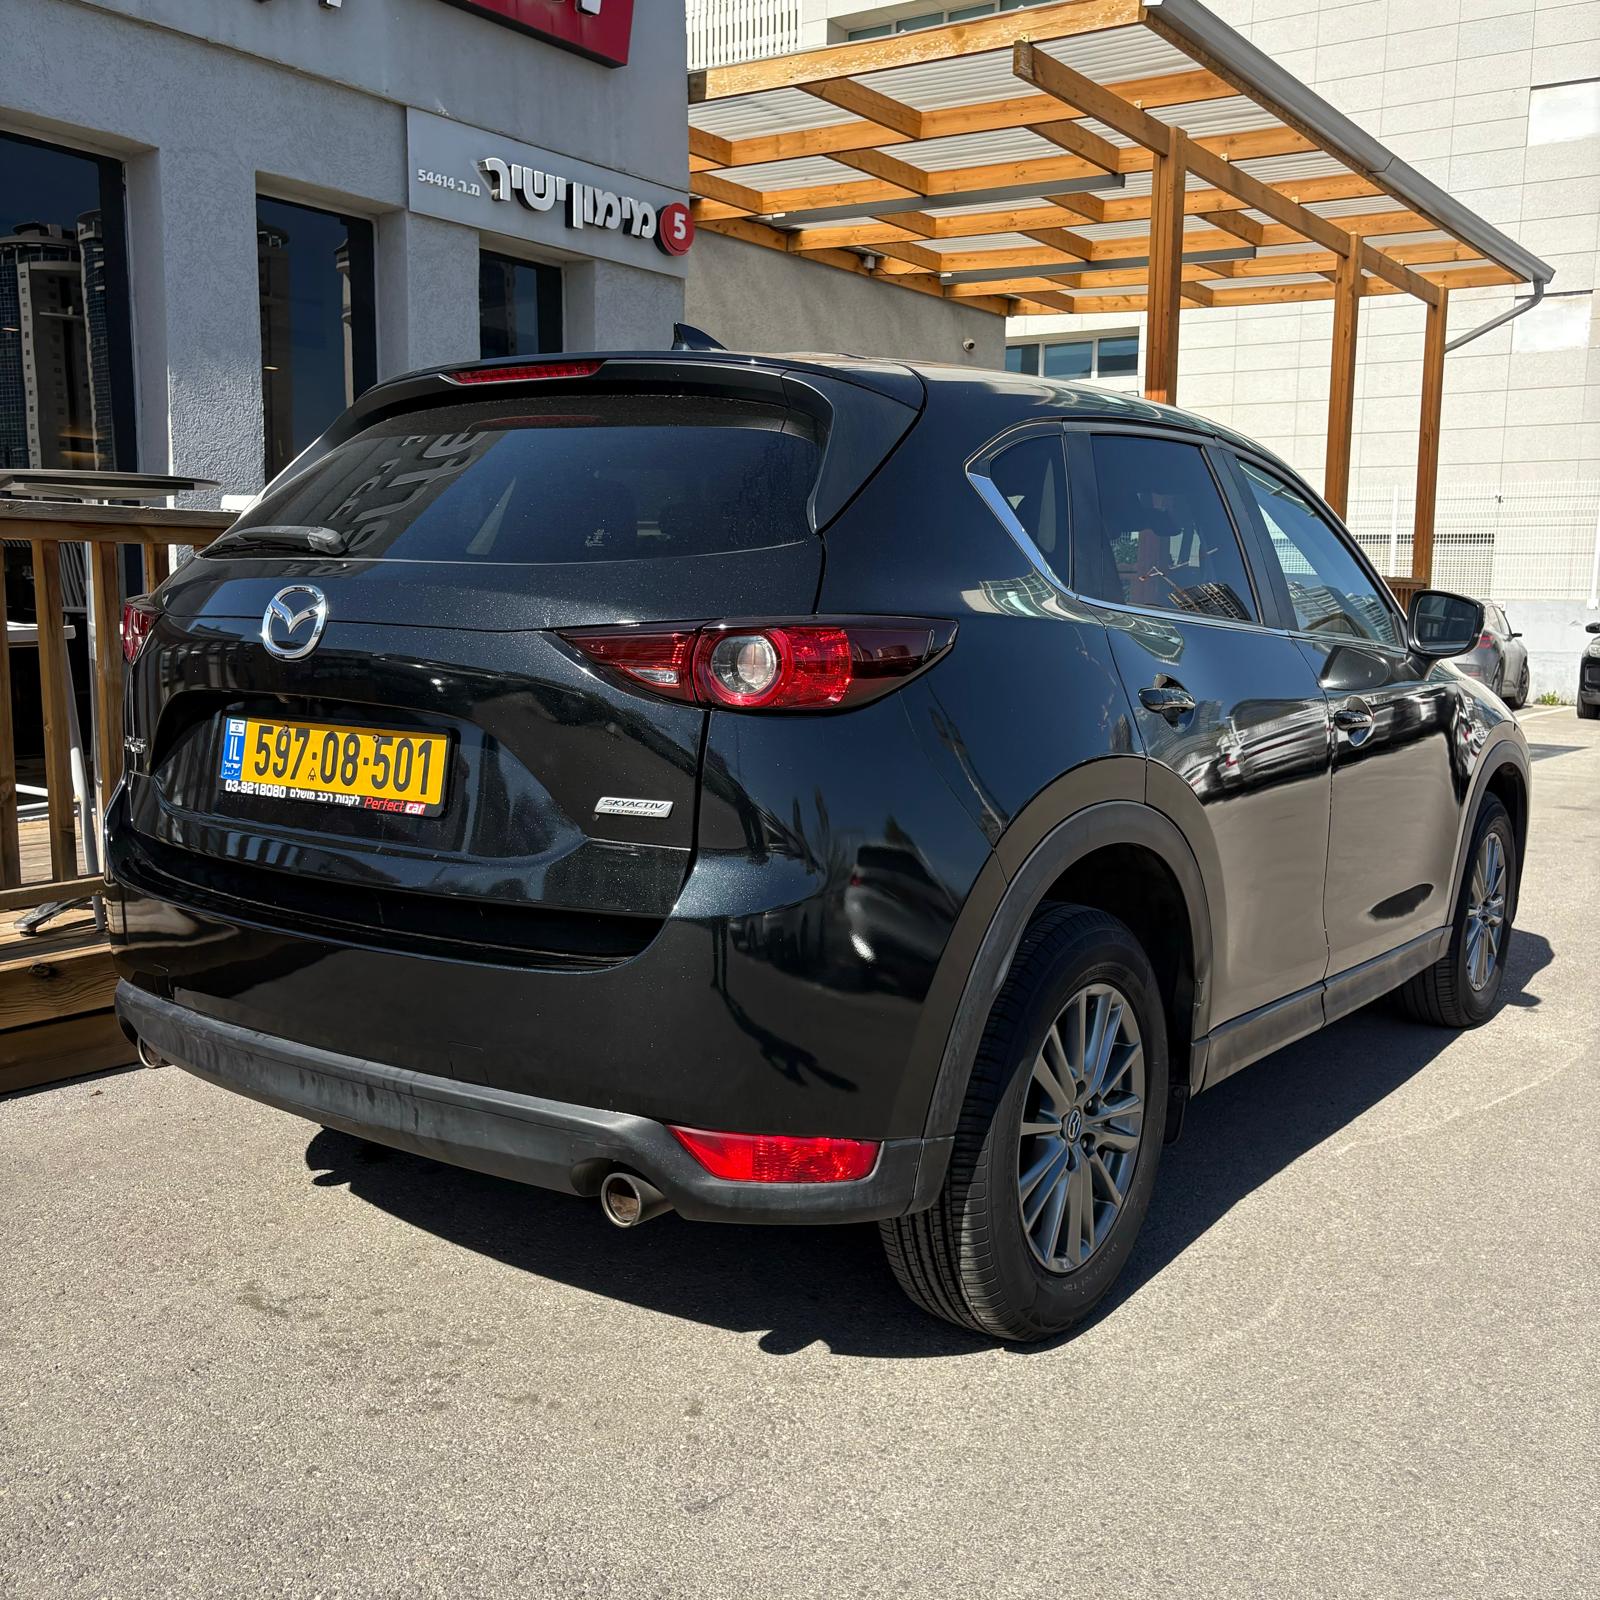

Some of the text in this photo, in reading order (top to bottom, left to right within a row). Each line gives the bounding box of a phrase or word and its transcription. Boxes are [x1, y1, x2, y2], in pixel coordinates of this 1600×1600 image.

[417, 168, 456, 190] 54414
[484, 157, 687, 240] 5 מימון ישיר
[229, 736, 240, 761] IL
[289, 788, 360, 807] לקנות רכב מושלם
[364, 797, 426, 815] Perfect car
[603, 799, 665, 809] SKYACTIV
